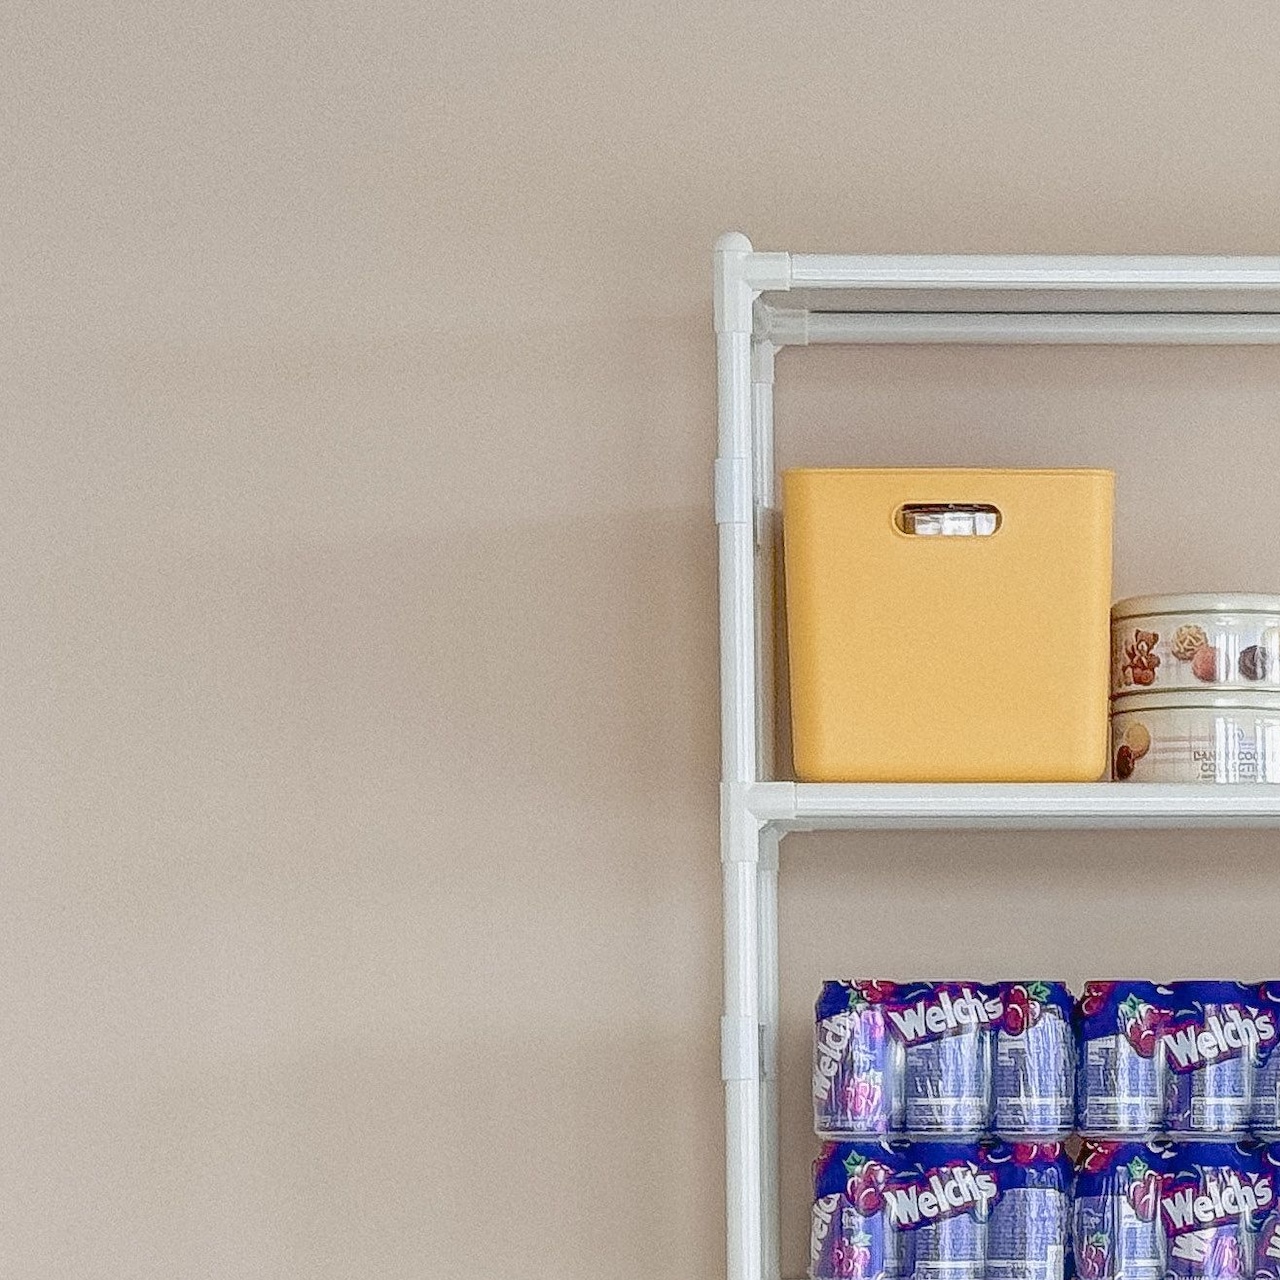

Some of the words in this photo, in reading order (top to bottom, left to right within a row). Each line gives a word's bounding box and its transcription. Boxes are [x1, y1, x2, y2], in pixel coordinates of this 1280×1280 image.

[888, 988, 1003, 1043] Welch's
[1163, 1004, 1276, 1068] Welch's
[815, 1011, 855, 1101] Welch
[883, 1160, 998, 1224] Welch's
[1162, 1172, 1273, 1229] Welch's
